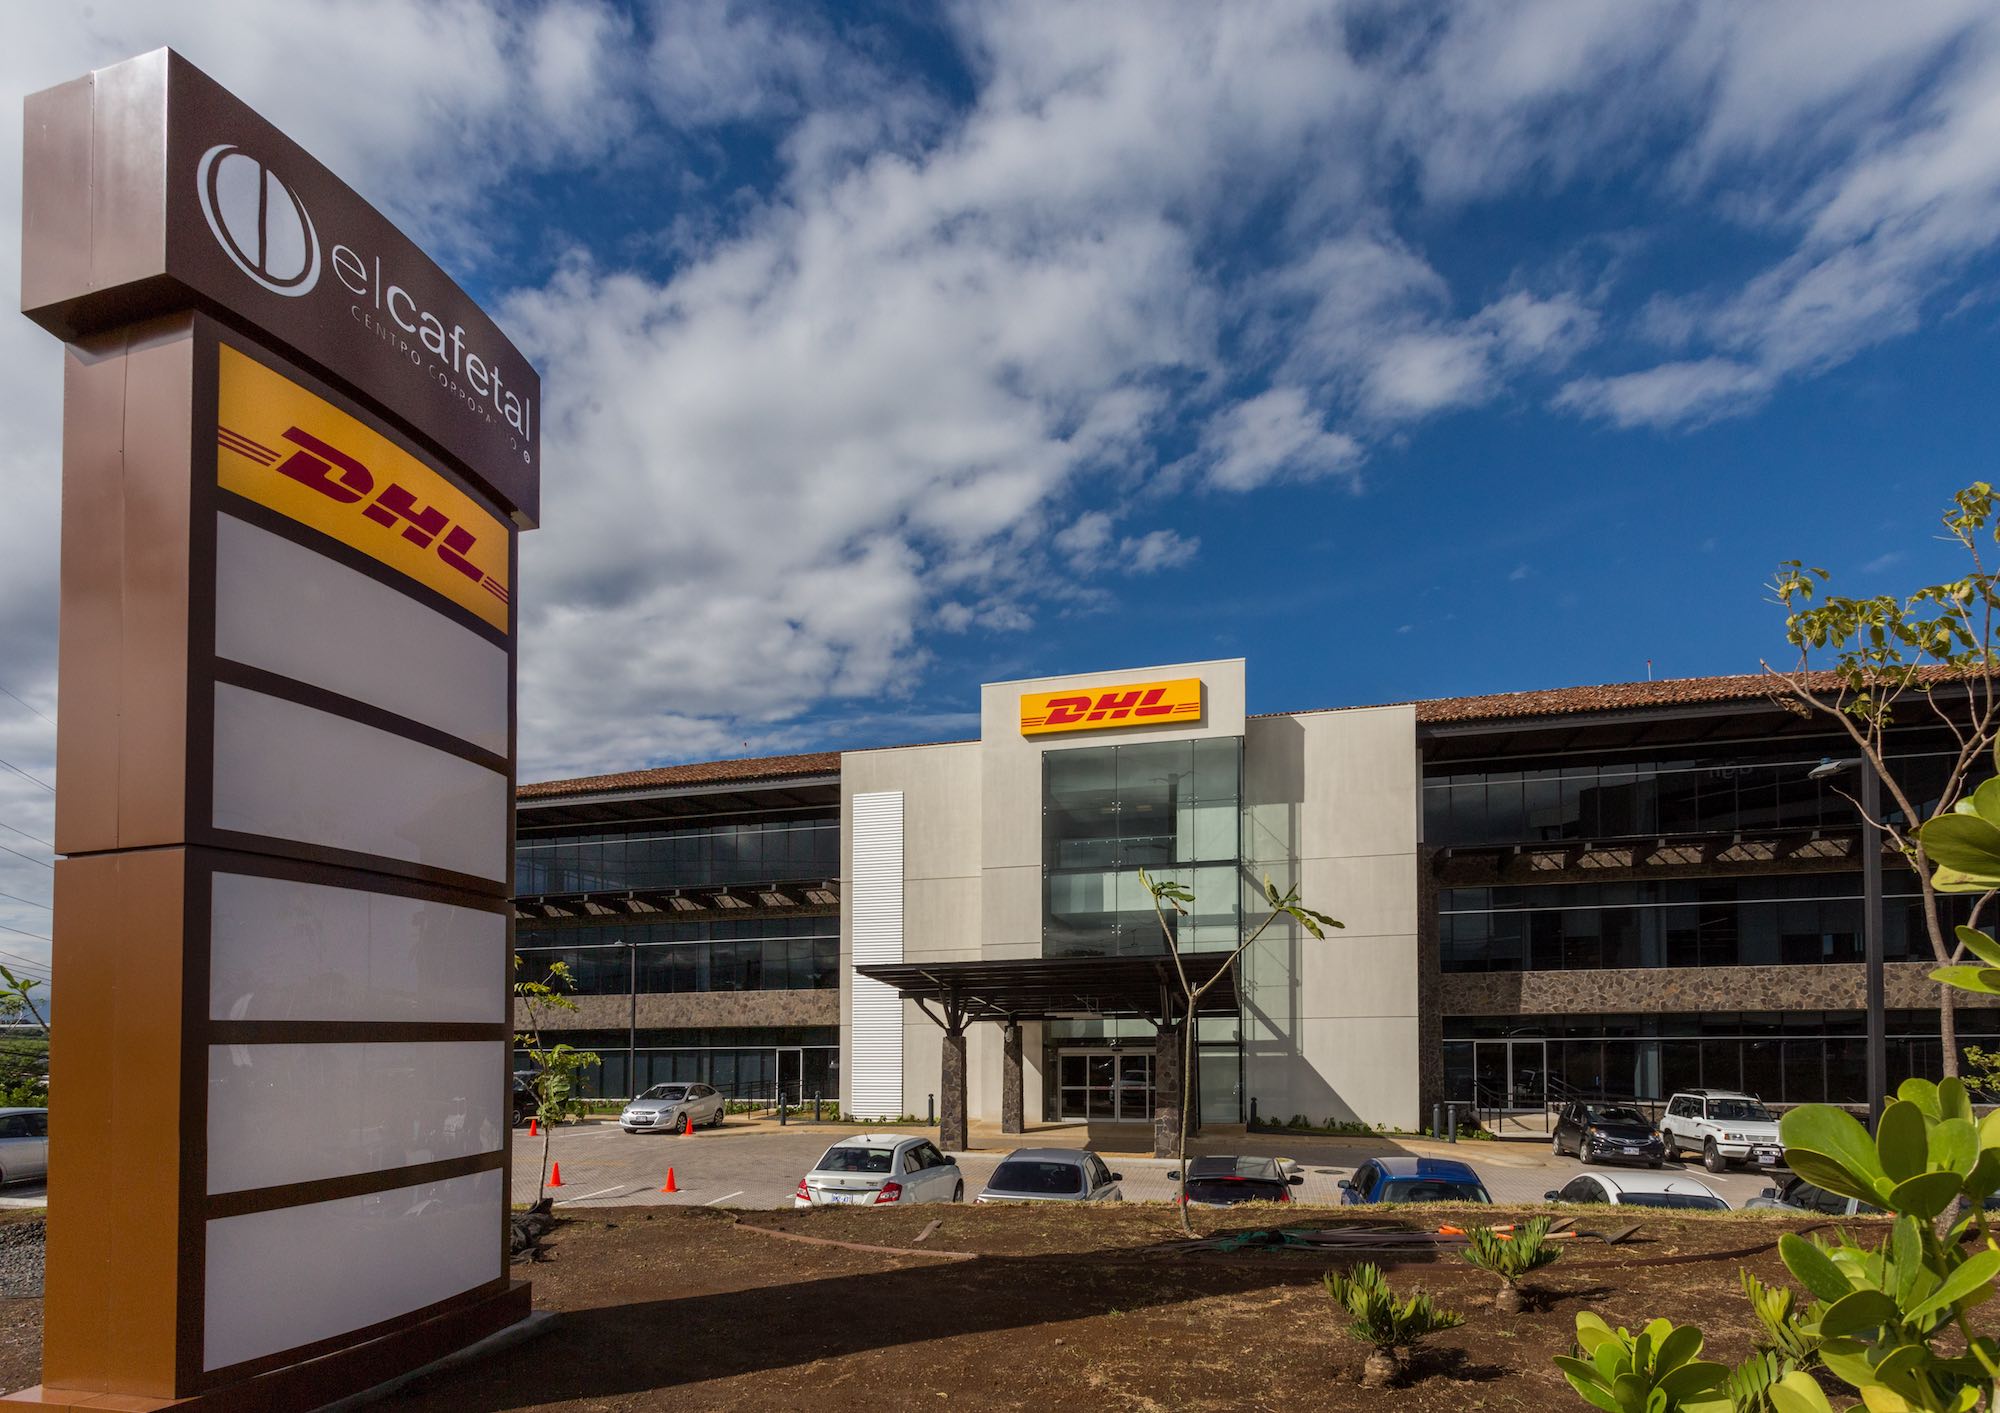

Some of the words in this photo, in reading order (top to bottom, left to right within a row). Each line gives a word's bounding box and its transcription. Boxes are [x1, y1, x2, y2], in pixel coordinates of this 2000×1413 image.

[351, 305, 421, 366] CENTRO
[275, 426, 485, 583] DHL
[1043, 688, 1175, 725] DHL
